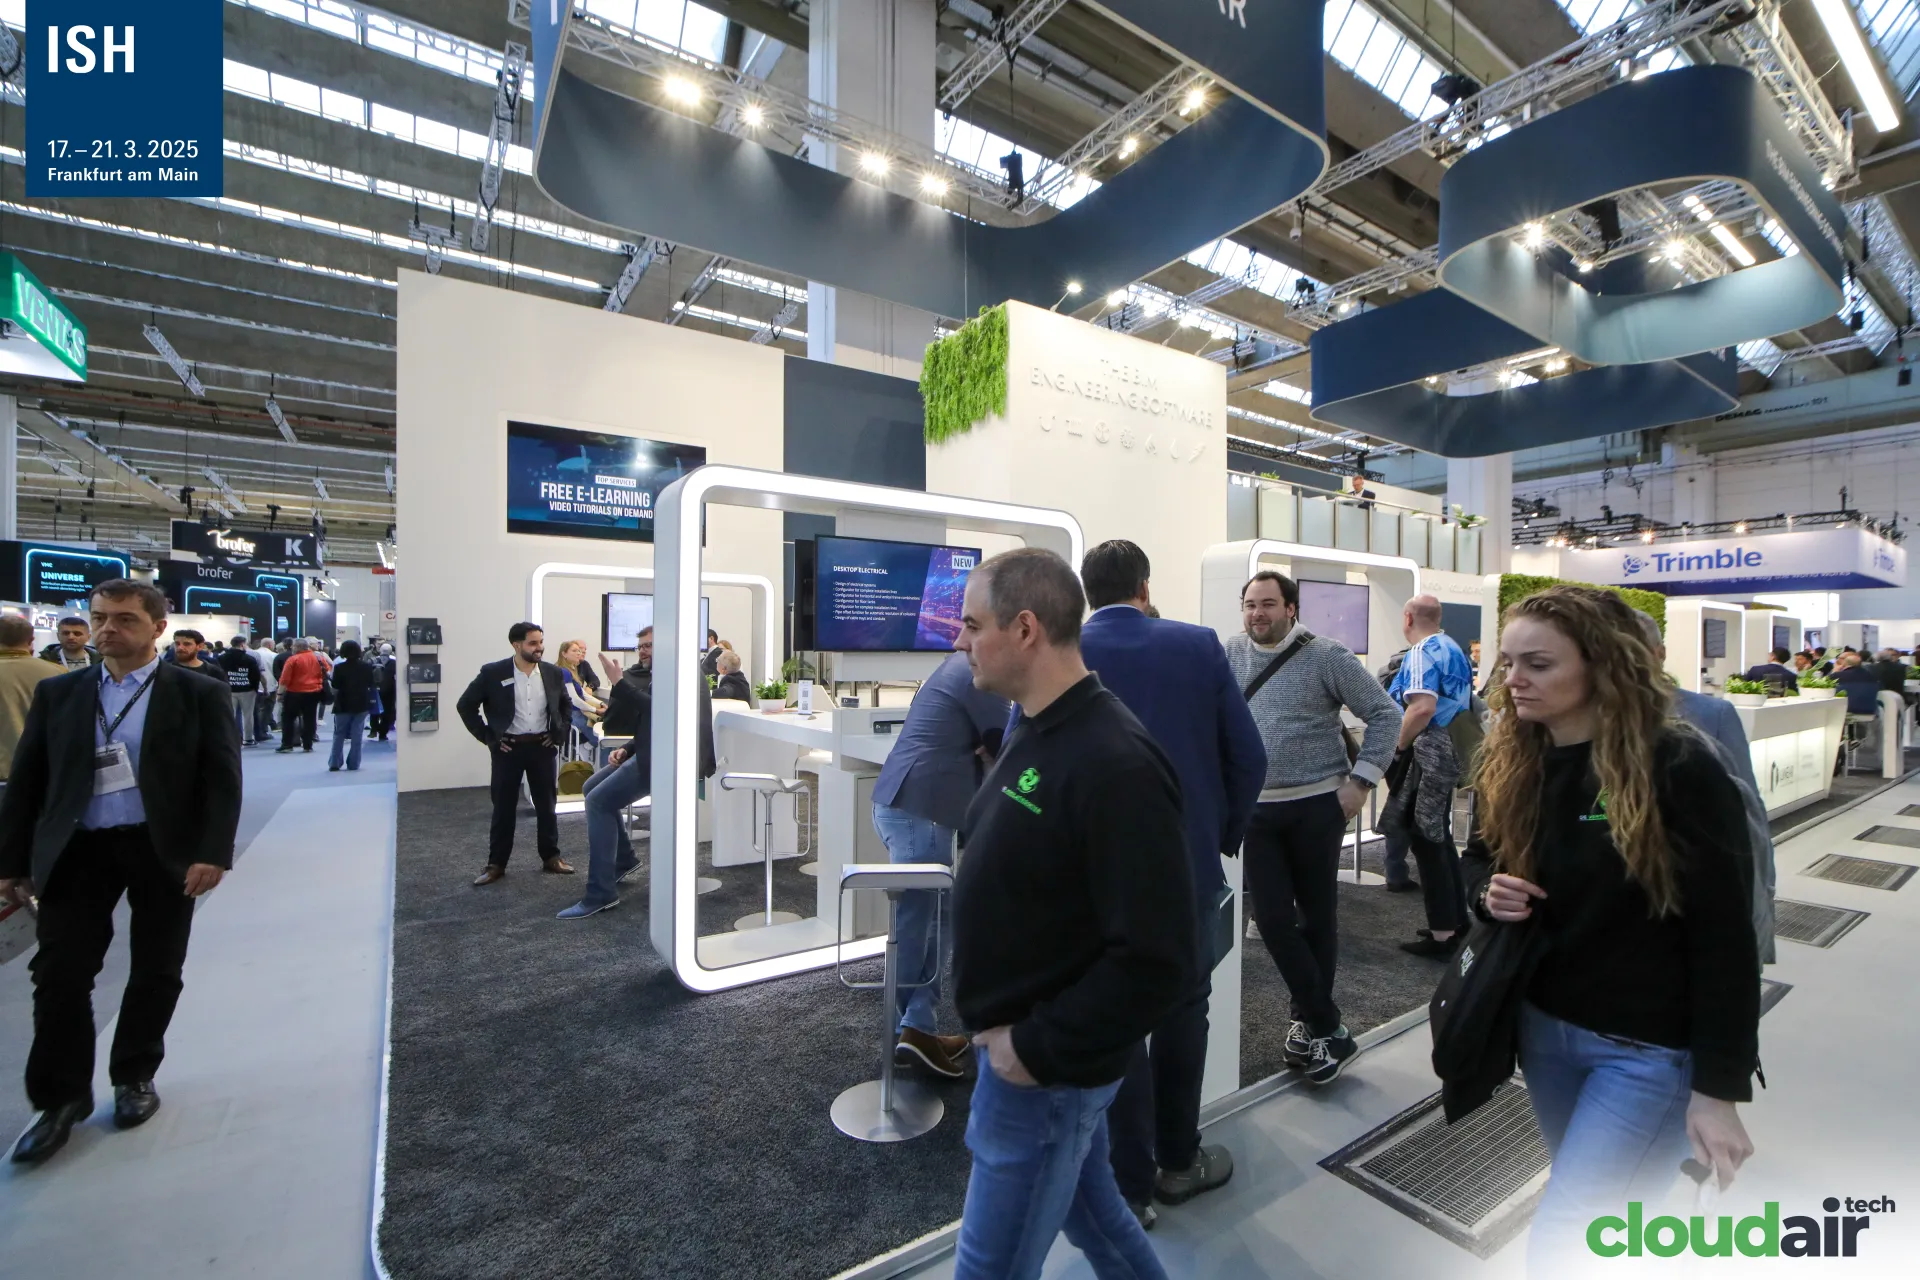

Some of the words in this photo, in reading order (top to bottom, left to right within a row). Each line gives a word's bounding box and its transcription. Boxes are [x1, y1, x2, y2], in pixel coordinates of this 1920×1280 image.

[1140, 395, 1213, 429] SOFTWARE
[597, 476, 608, 484] TOP
[609, 477, 635, 487] SERVICES
[541, 482, 573, 500] FREE
[577, 485, 650, 508] E-LEARNING
[549, 501, 571, 512] VIDEO
[573, 503, 611, 516] TUTORIALS
[613, 507, 623, 517] ON
[624, 508, 653, 519] DEMAND
[214, 531, 256, 554] brofer
[285, 538, 303, 557] K
[953, 557, 973, 568] NEW
[1651, 547, 1763, 573] Trimble
[41, 571, 85, 582] UNIVERSE
[197, 565, 233, 580] brofer
[833, 565, 858, 573] DESKTOP
[858, 567, 889, 575] ELECTRICAL
